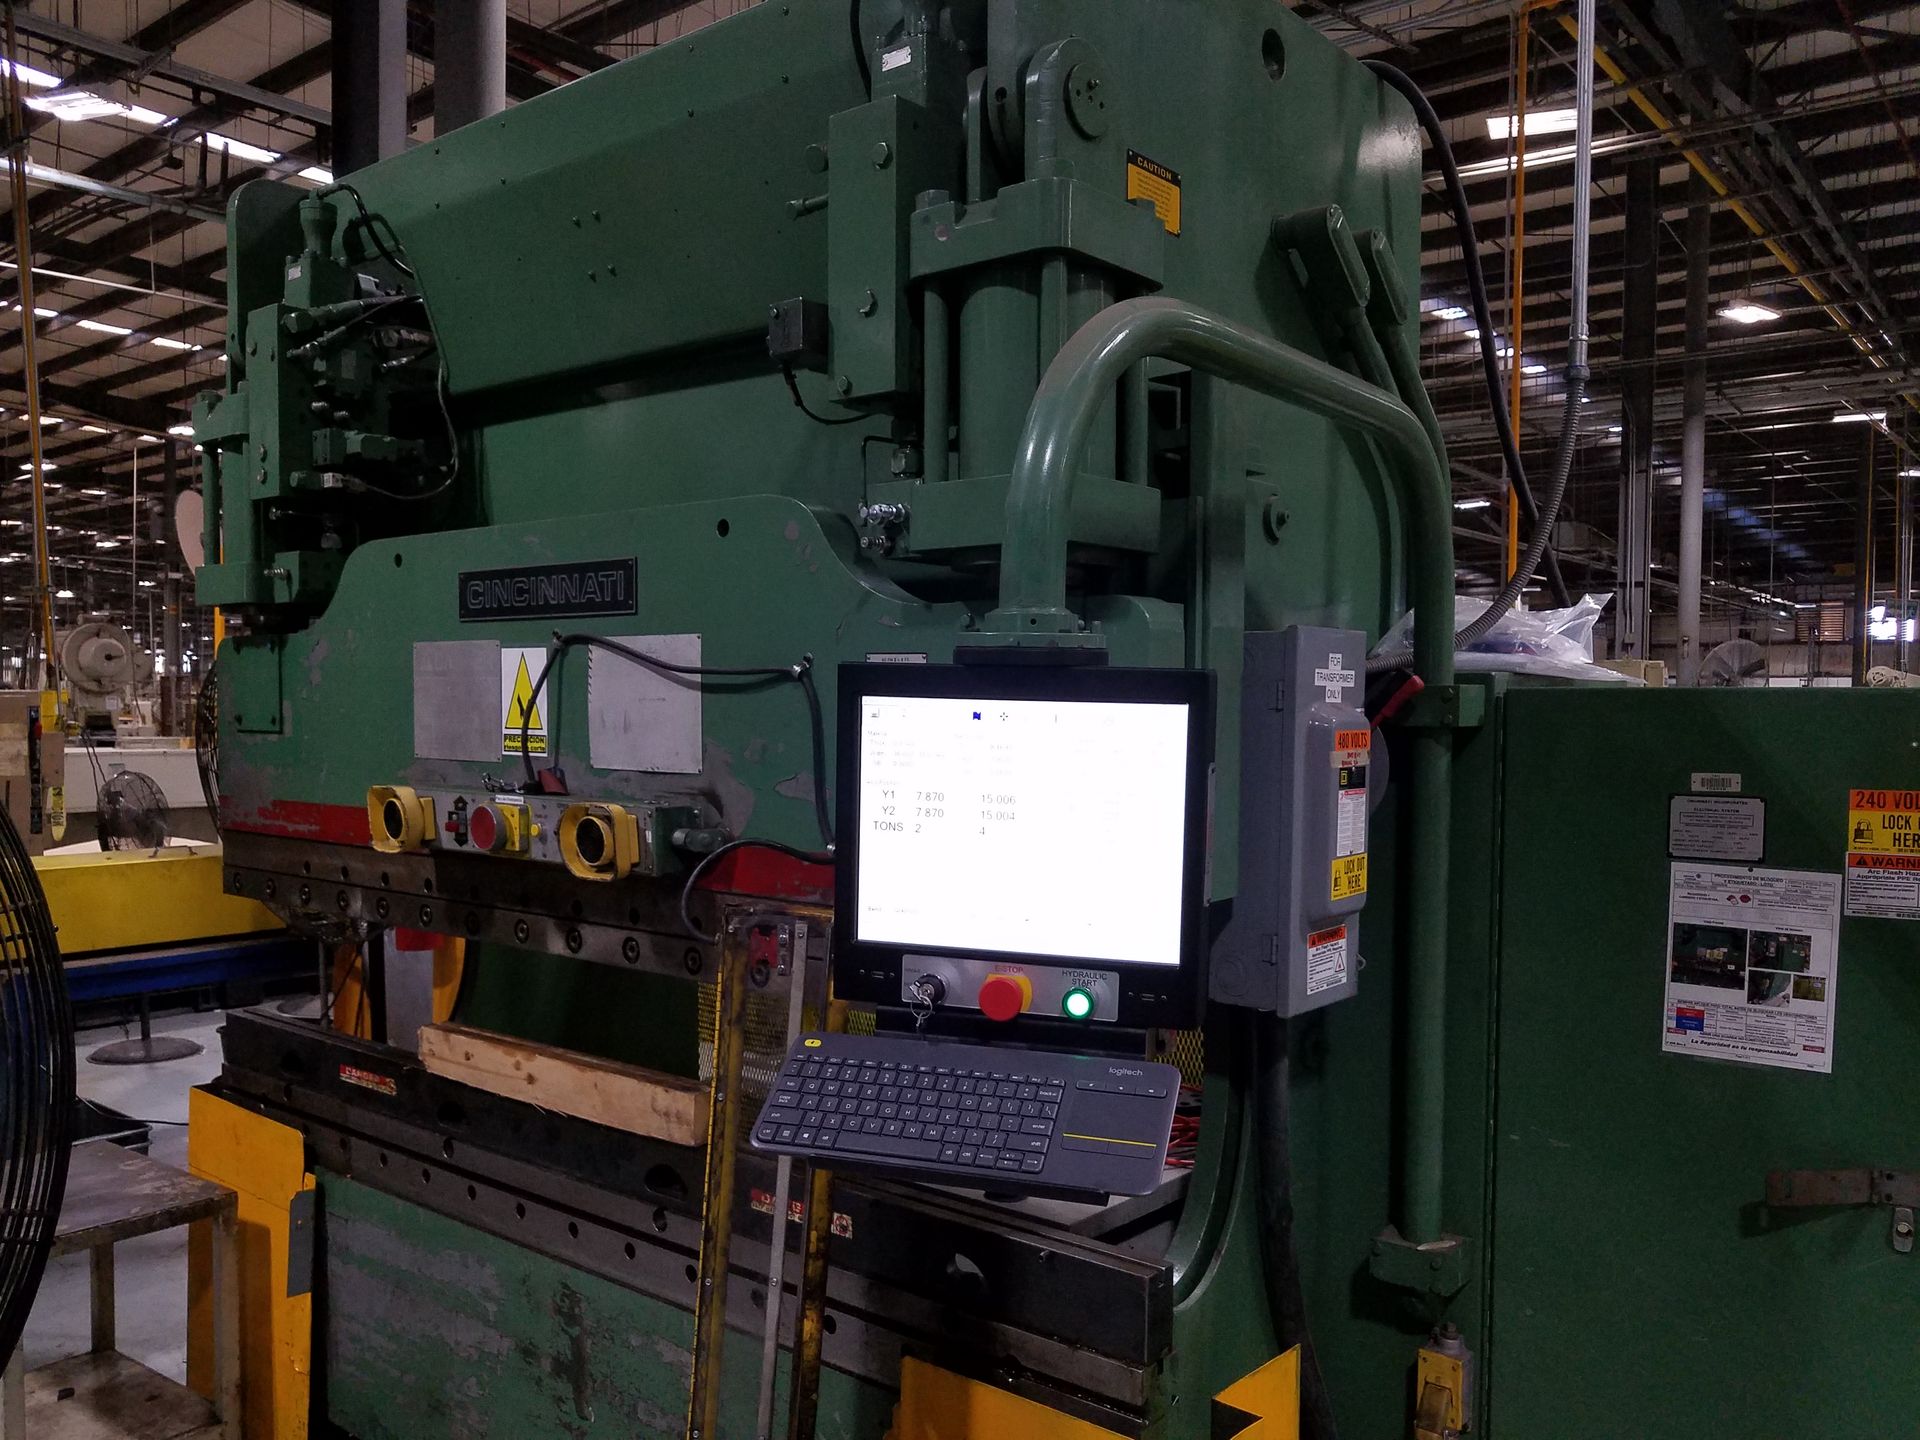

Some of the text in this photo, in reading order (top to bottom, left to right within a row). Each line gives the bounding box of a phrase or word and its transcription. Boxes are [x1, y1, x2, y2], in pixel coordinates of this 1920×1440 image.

[1137, 157, 1172, 180] CAUTION
[467, 571, 625, 609] CINCINNATI
[1330, 656, 1341, 667] FOR
[1316, 671, 1354, 683] TRANSFORMER
[1327, 689, 1341, 699] ONLY
[1338, 732, 1368, 749] 480 VOLTS
[882, 789, 1016, 805] Y1 7870 15006
[1855, 791, 1887, 809] 240
[881, 805, 1016, 821] Y2 7870 15004
[873, 820, 986, 836] TONS 2 4
[1882, 814, 1912, 830] LOCK
[1344, 857, 1366, 875] LOCK OUT
[1347, 874, 1362, 890] HERE
[1061, 970, 1108, 981] HYDRAULIC
[1071, 978, 1098, 988] START
[1108, 1066, 1143, 1077] logitech
